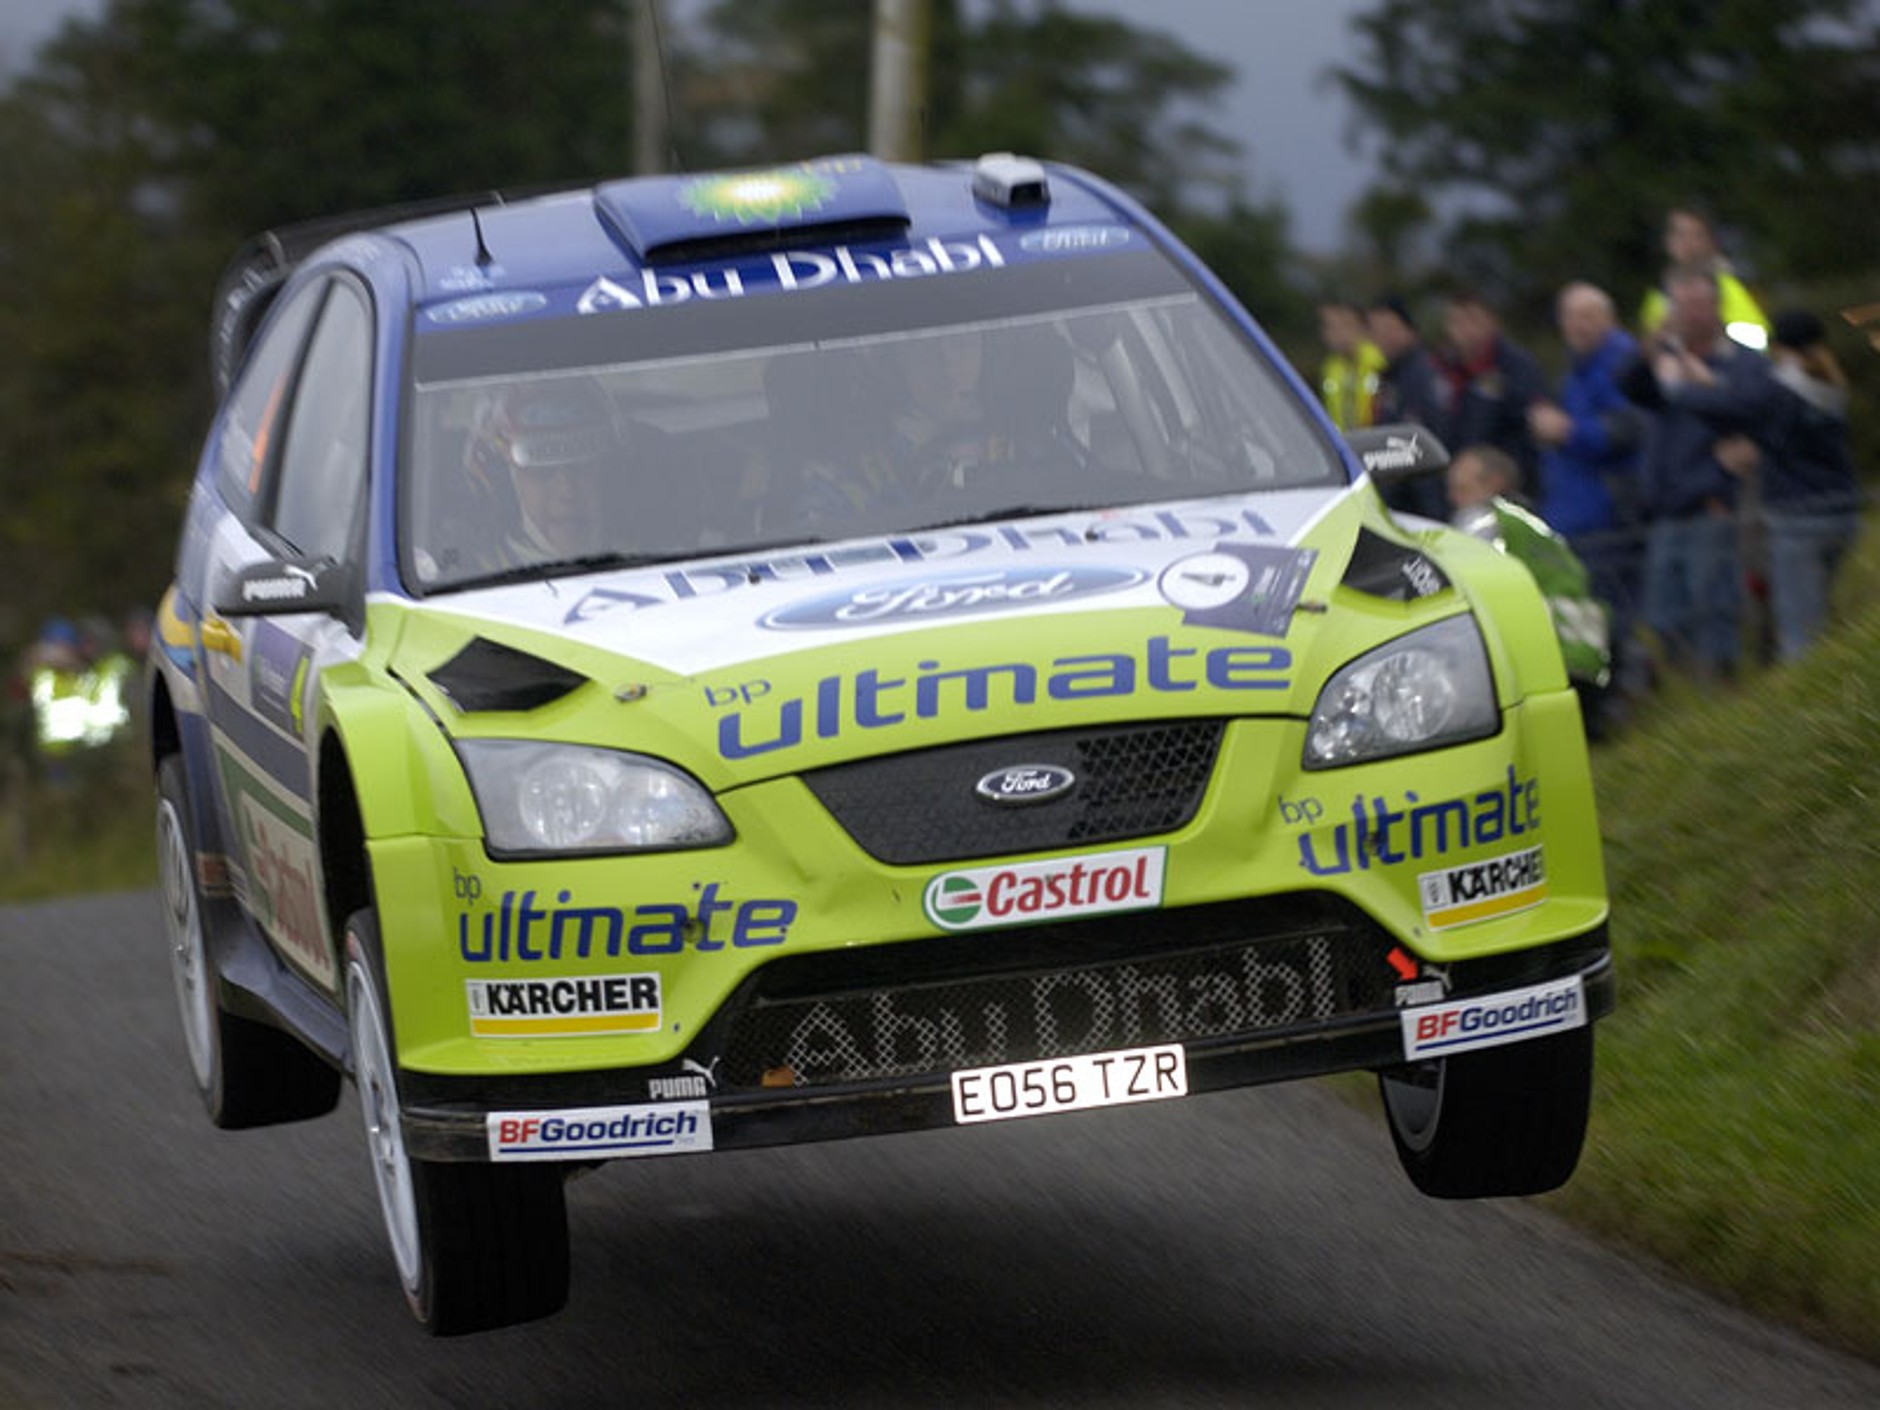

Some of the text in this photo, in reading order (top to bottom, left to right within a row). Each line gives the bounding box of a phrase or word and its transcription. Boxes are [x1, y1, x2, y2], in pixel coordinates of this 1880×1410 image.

[576, 268, 747, 314] Abu
[770, 233, 1005, 291] Dhabi
[834, 570, 1075, 621] Ford
[704, 679, 772, 707] bp
[718, 635, 1293, 761] ultimate
[1001, 770, 1051, 793] Ford
[1278, 793, 1324, 825] bp
[1298, 763, 1541, 876] ultimate
[453, 867, 482, 906] bp
[986, 855, 1150, 918] Castrol
[458, 882, 798, 963] ultimate
[486, 976, 660, 1016] KÄRCHER
[784, 936, 1336, 1086] Abu Dhabi
[1415, 988, 1578, 1041] BFGoodrich
[648, 1075, 707, 1100] PUMA
[1092, 1051, 1179, 1100] TZR
[498, 1110, 698, 1144] BFGoodrich
